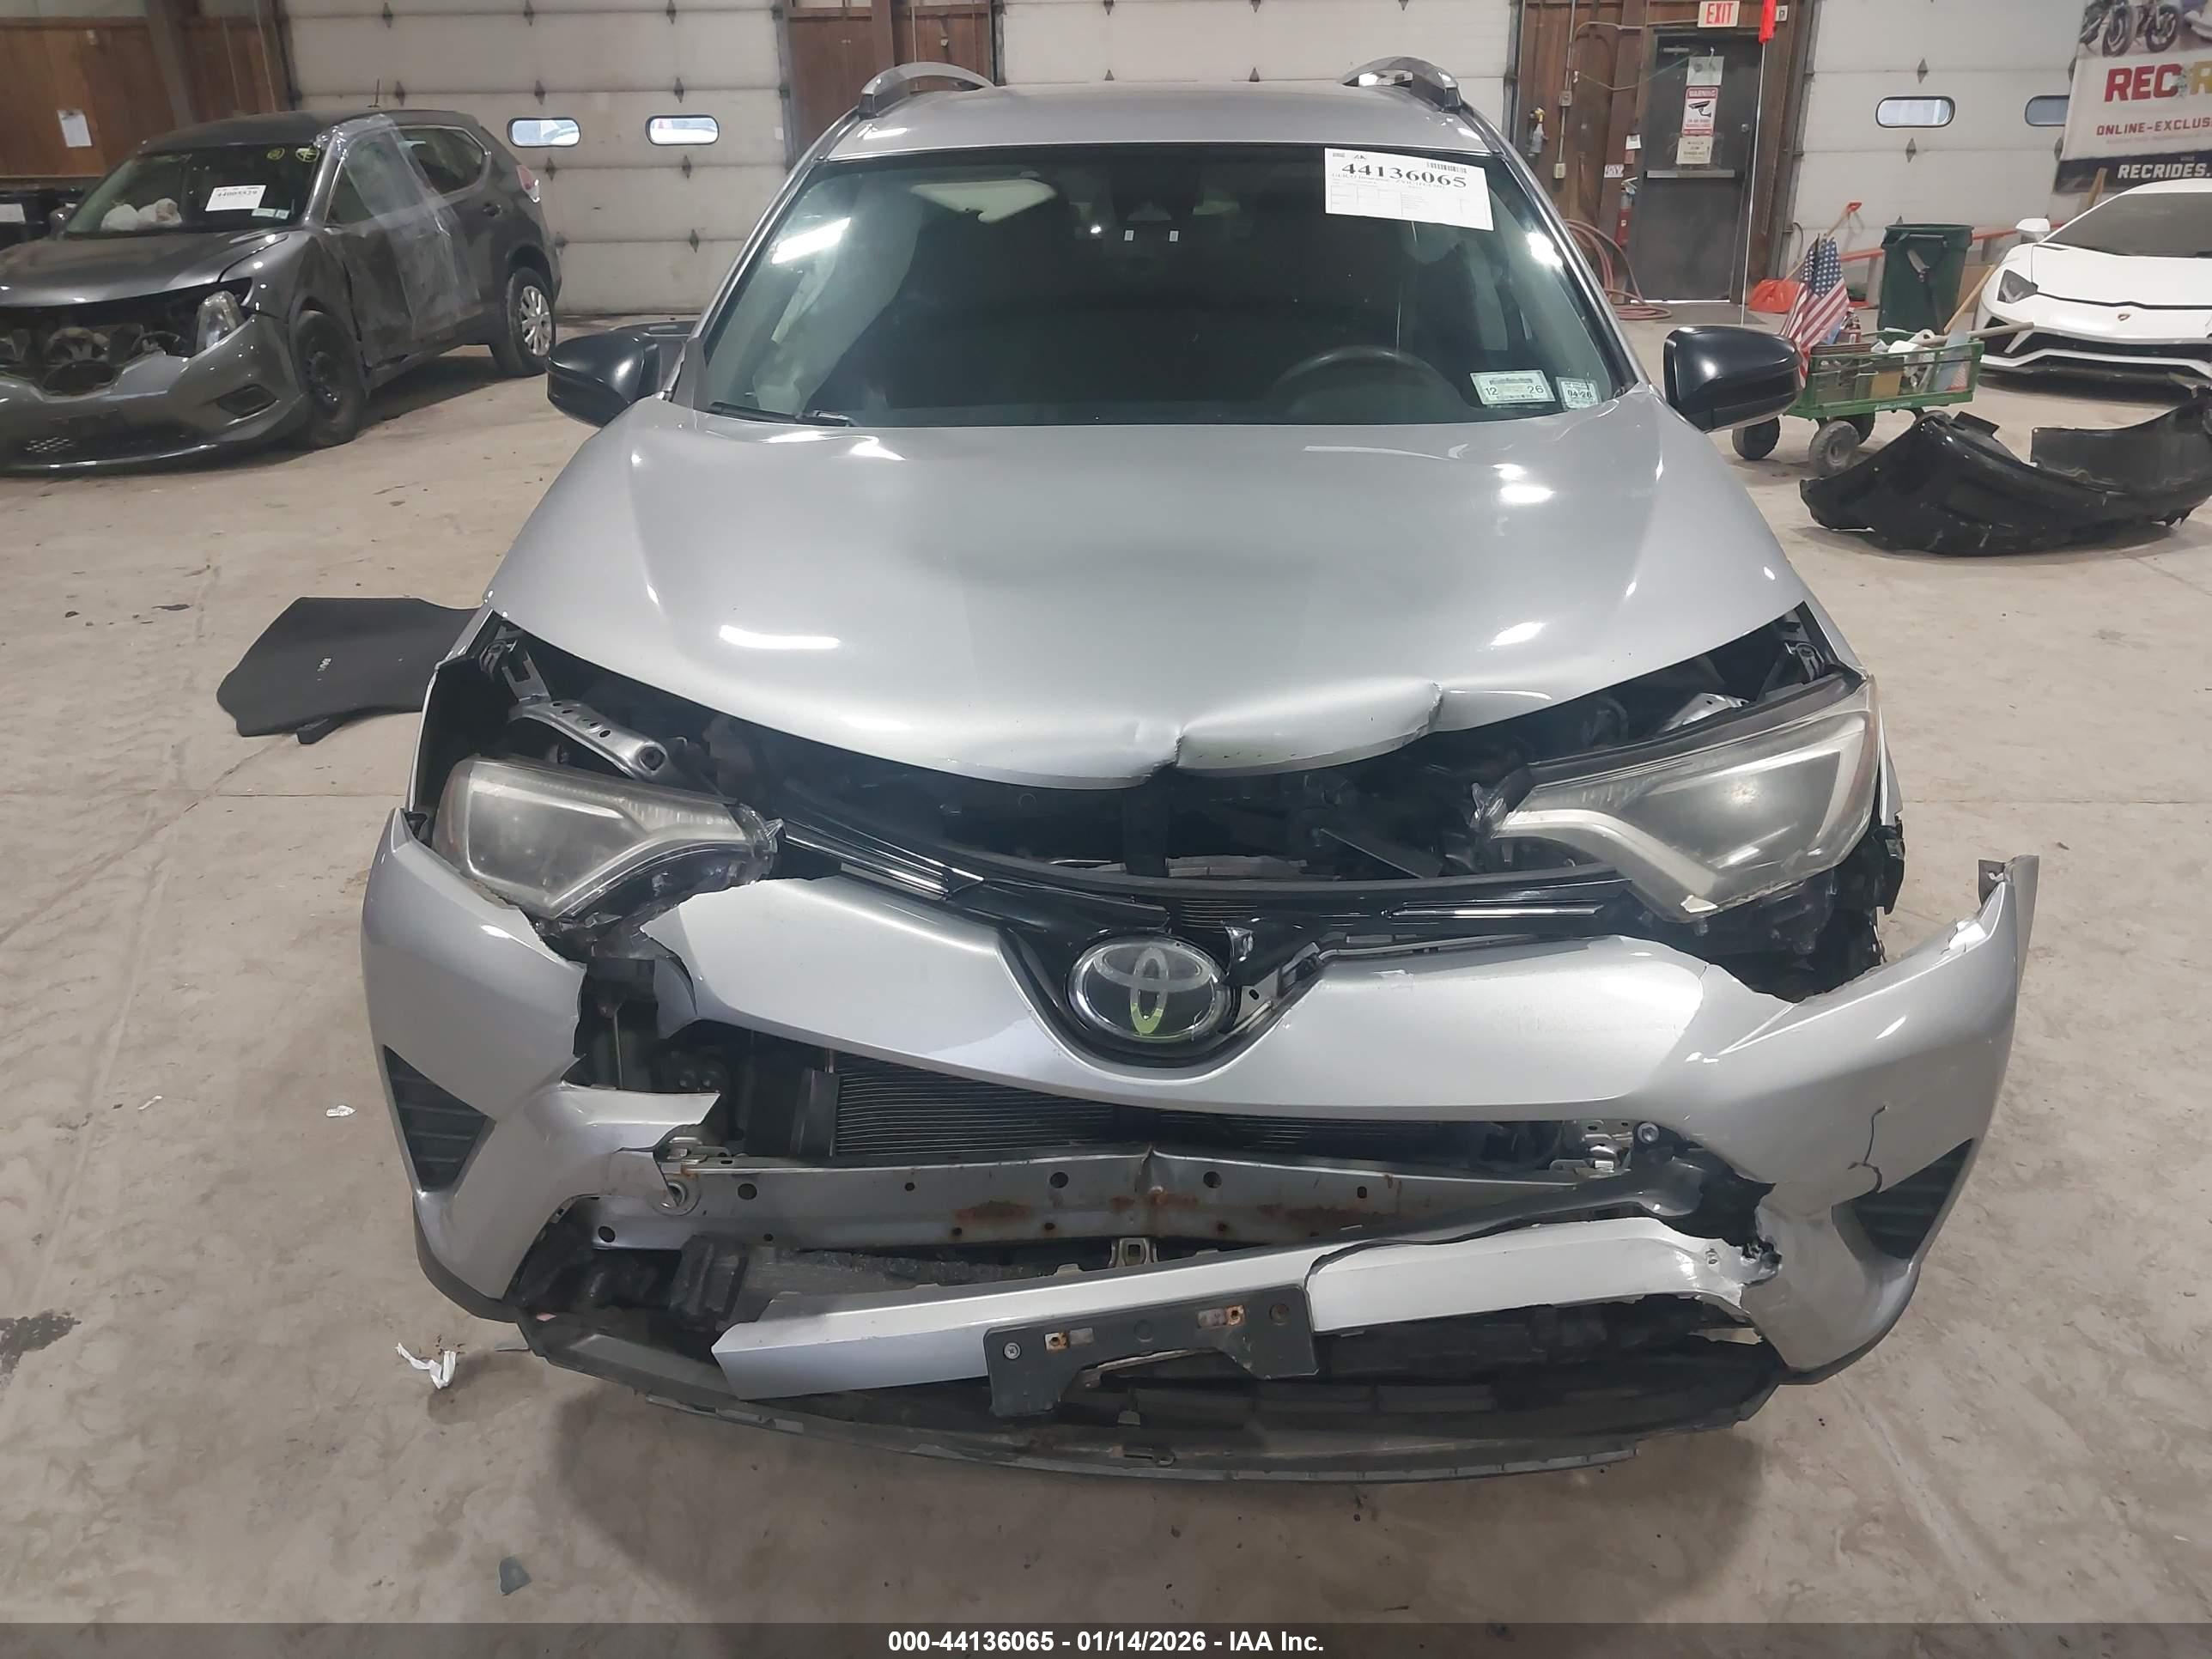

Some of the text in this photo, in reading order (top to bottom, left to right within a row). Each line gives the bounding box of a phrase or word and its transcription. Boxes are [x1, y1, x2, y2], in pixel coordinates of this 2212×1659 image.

[1706, 3, 1734, 24] EXIT
[1341, 163, 1468, 188] 44136065
[1486, 385, 1544, 396] 12 26
